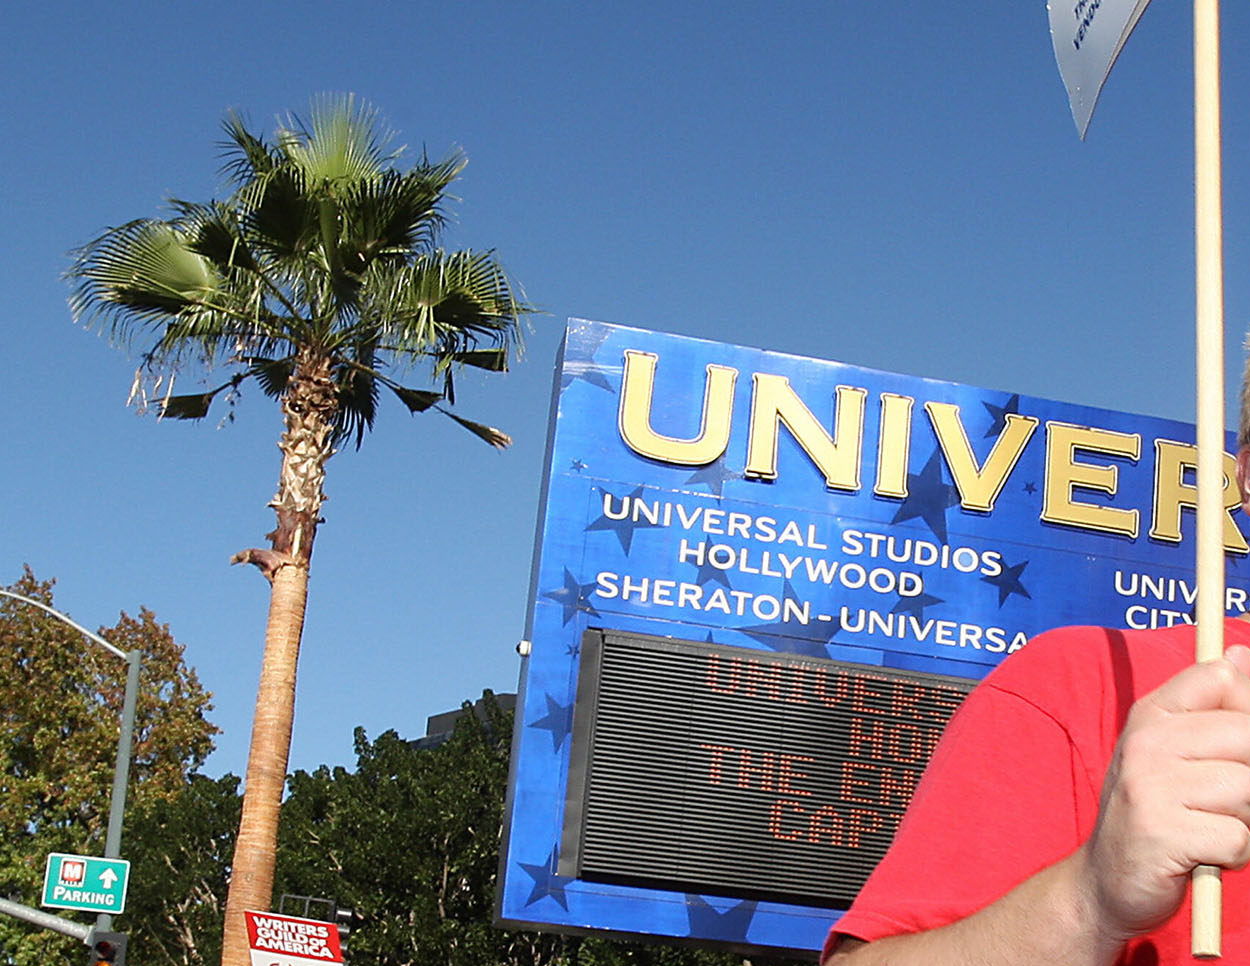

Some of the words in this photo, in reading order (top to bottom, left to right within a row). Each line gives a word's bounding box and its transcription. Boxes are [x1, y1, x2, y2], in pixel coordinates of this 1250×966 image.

[602, 493, 829, 571] UNIVERSAL
[841, 529, 1003, 577] STUDIOS
[678, 538, 924, 598] HOLLYWOOD
[706, 654, 963, 723] UNIVERS
[701, 743, 815, 797] THE
[841, 761, 925, 808] EN
[252, 915, 329, 938] WRITERS
[255, 937, 335, 959] AMERICA
[256, 927, 308, 945] GUILD
